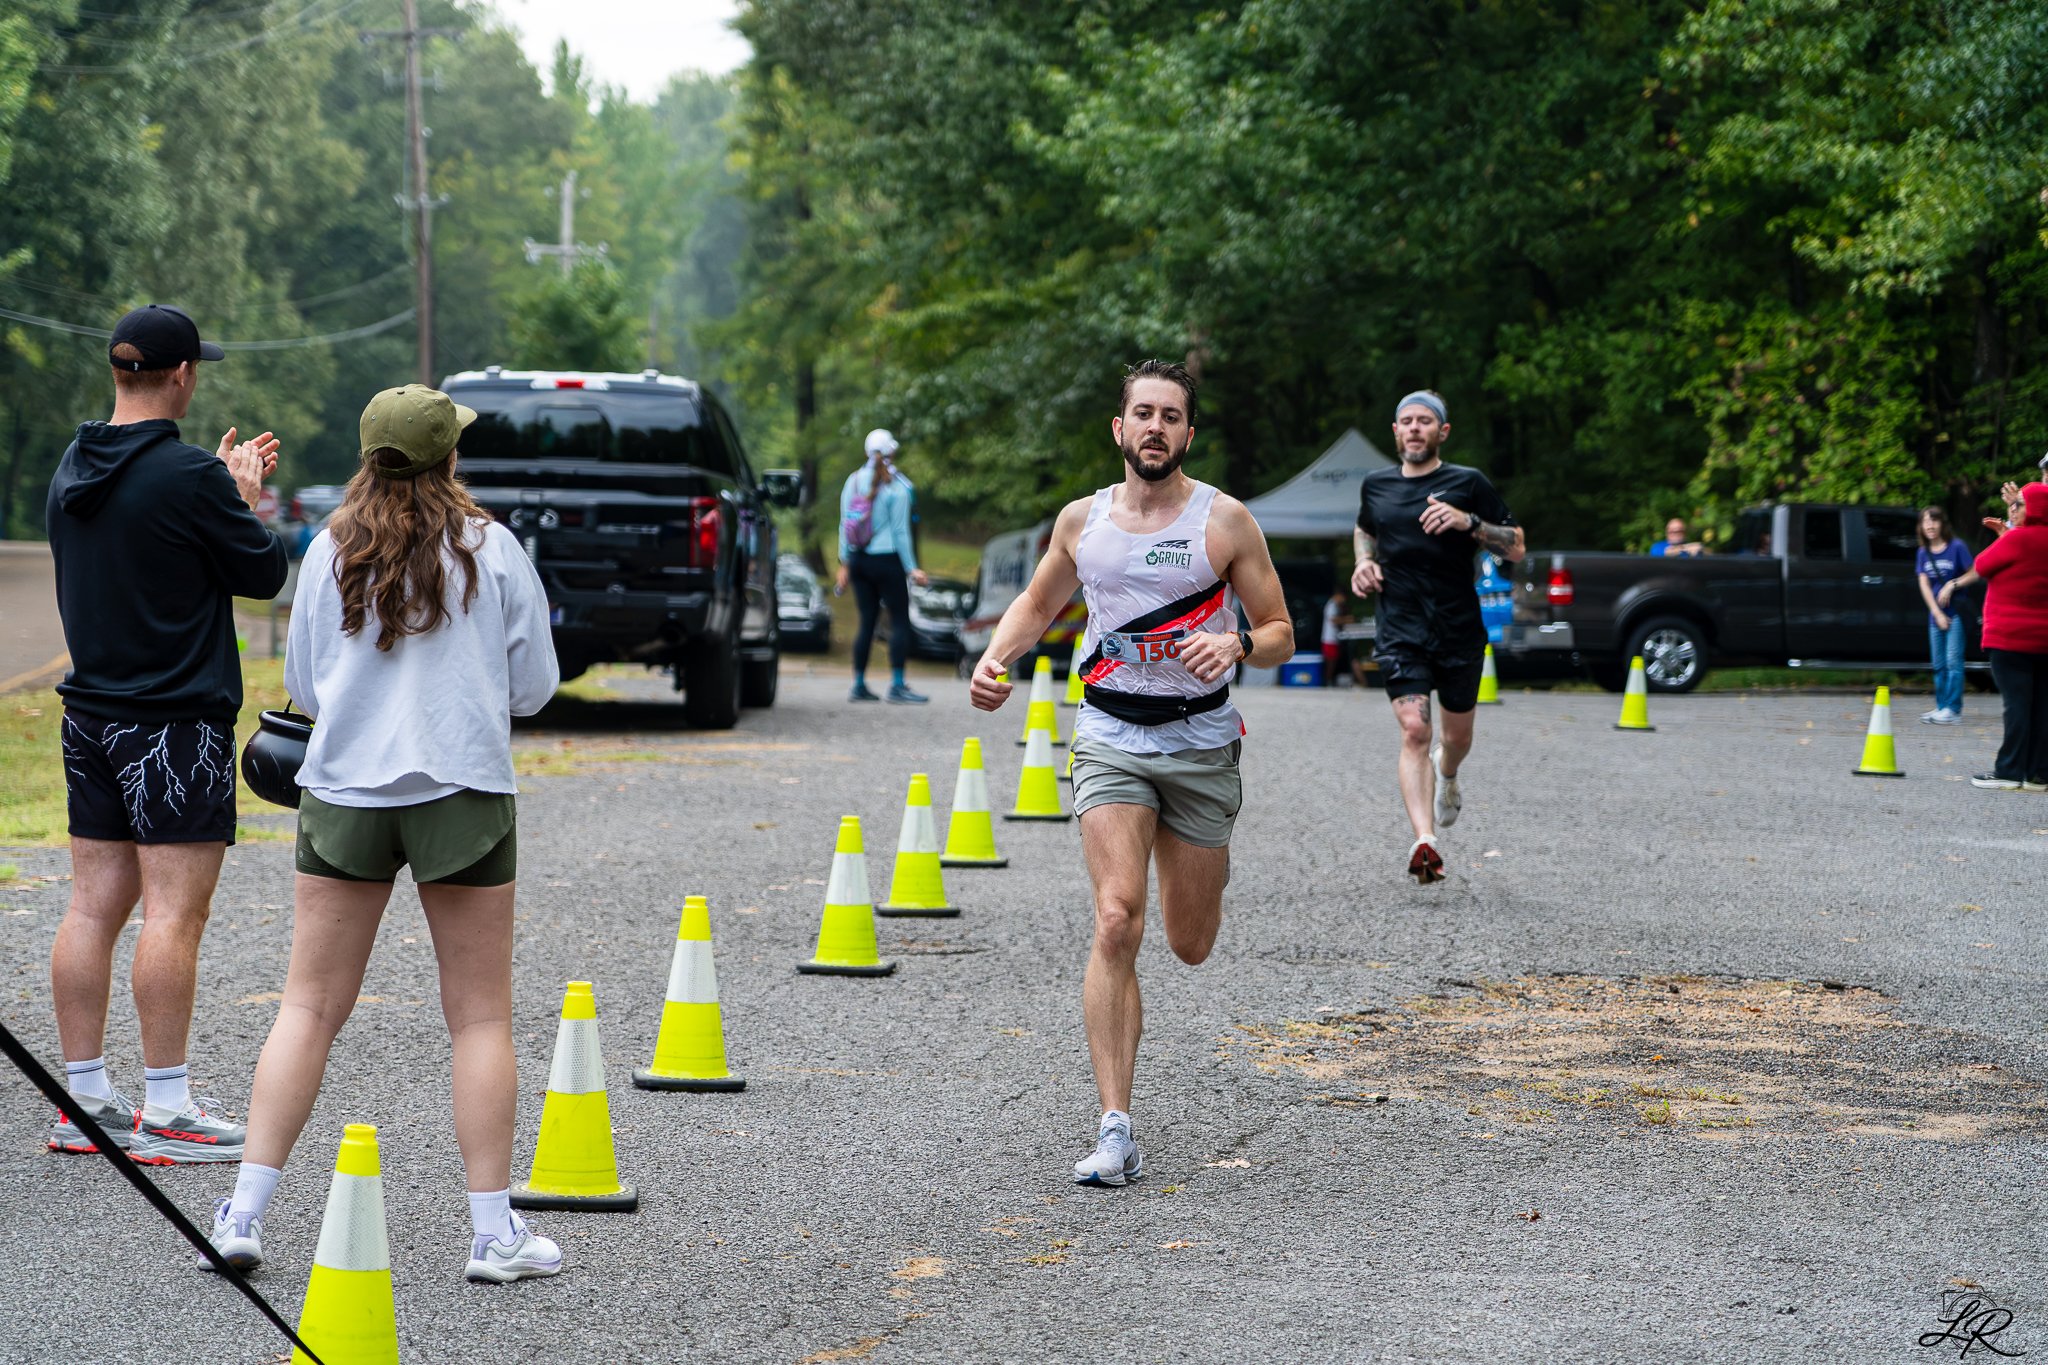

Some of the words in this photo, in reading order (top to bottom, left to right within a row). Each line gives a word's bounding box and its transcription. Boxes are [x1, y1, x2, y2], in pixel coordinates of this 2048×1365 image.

[1158, 551, 1193, 566] GRIVET
[1143, 633, 1172, 641] Benjamin
[1136, 640, 1181, 662] 150
[149, 1128, 219, 1144] ALTRA
